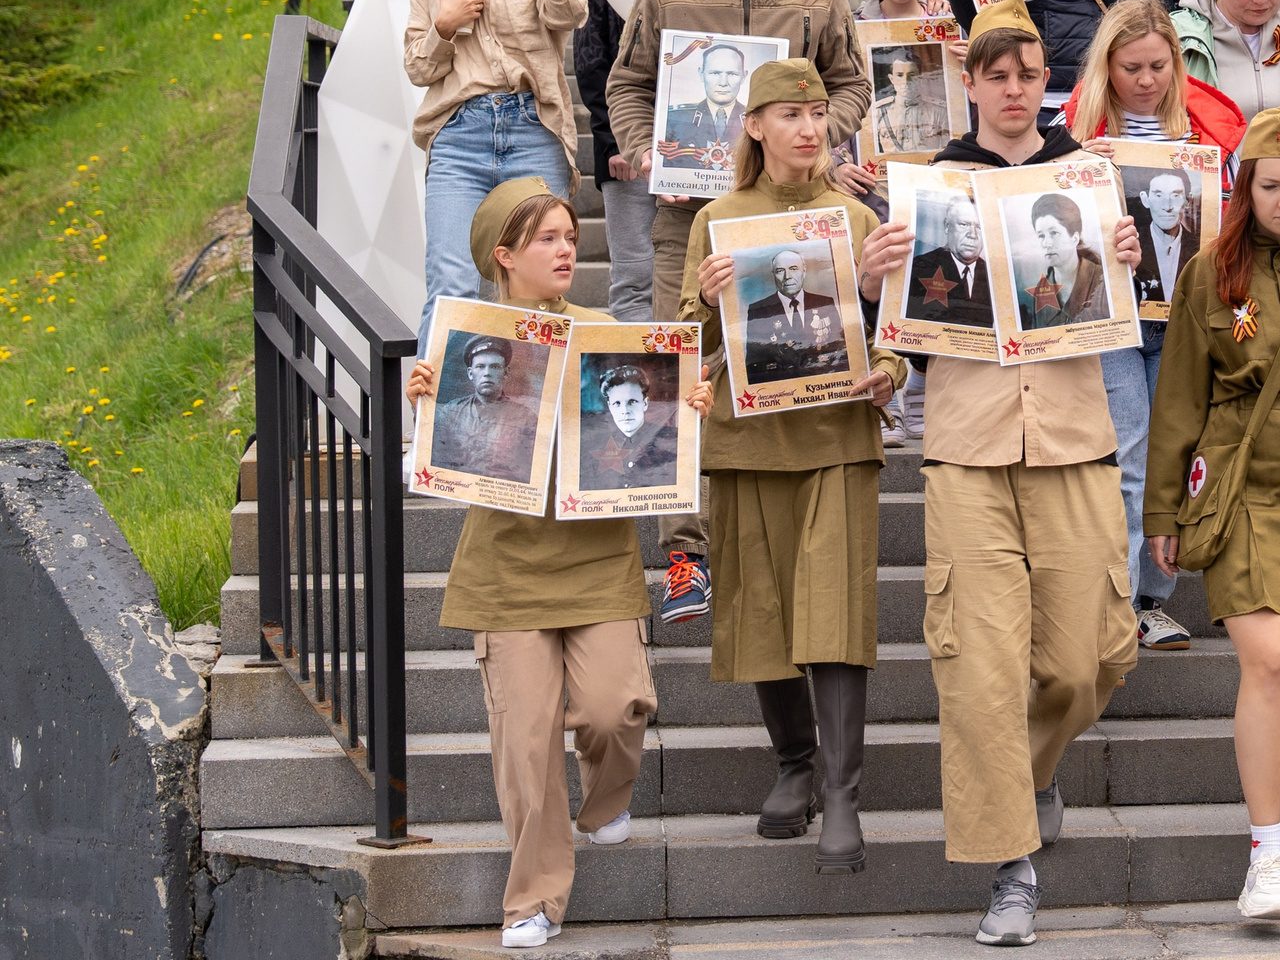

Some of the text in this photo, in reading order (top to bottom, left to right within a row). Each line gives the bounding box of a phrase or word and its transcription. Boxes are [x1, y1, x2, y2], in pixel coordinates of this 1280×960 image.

[935, 25, 946, 41] 9
[1193, 154, 1204, 171] 9
[694, 171, 734, 182] Чернако
[1081, 169, 1094, 188] 9
[657, 180, 710, 192] Александр
[818, 219, 830, 240] 9
[540, 323, 553, 345] 9
[900, 336, 923, 346] ПОЛК
[669, 333, 681, 353] 9
[1024, 346, 1047, 356] ПОЛК
[805, 379, 854, 394] Кузьминых
[758, 399, 781, 408] ПОЛК
[792, 388, 869, 405] Михаил Иванич
[434, 482, 456, 494] ПОЛК
[627, 492, 678, 503] Тонконогов
[612, 501, 694, 514] Николай Павлович
